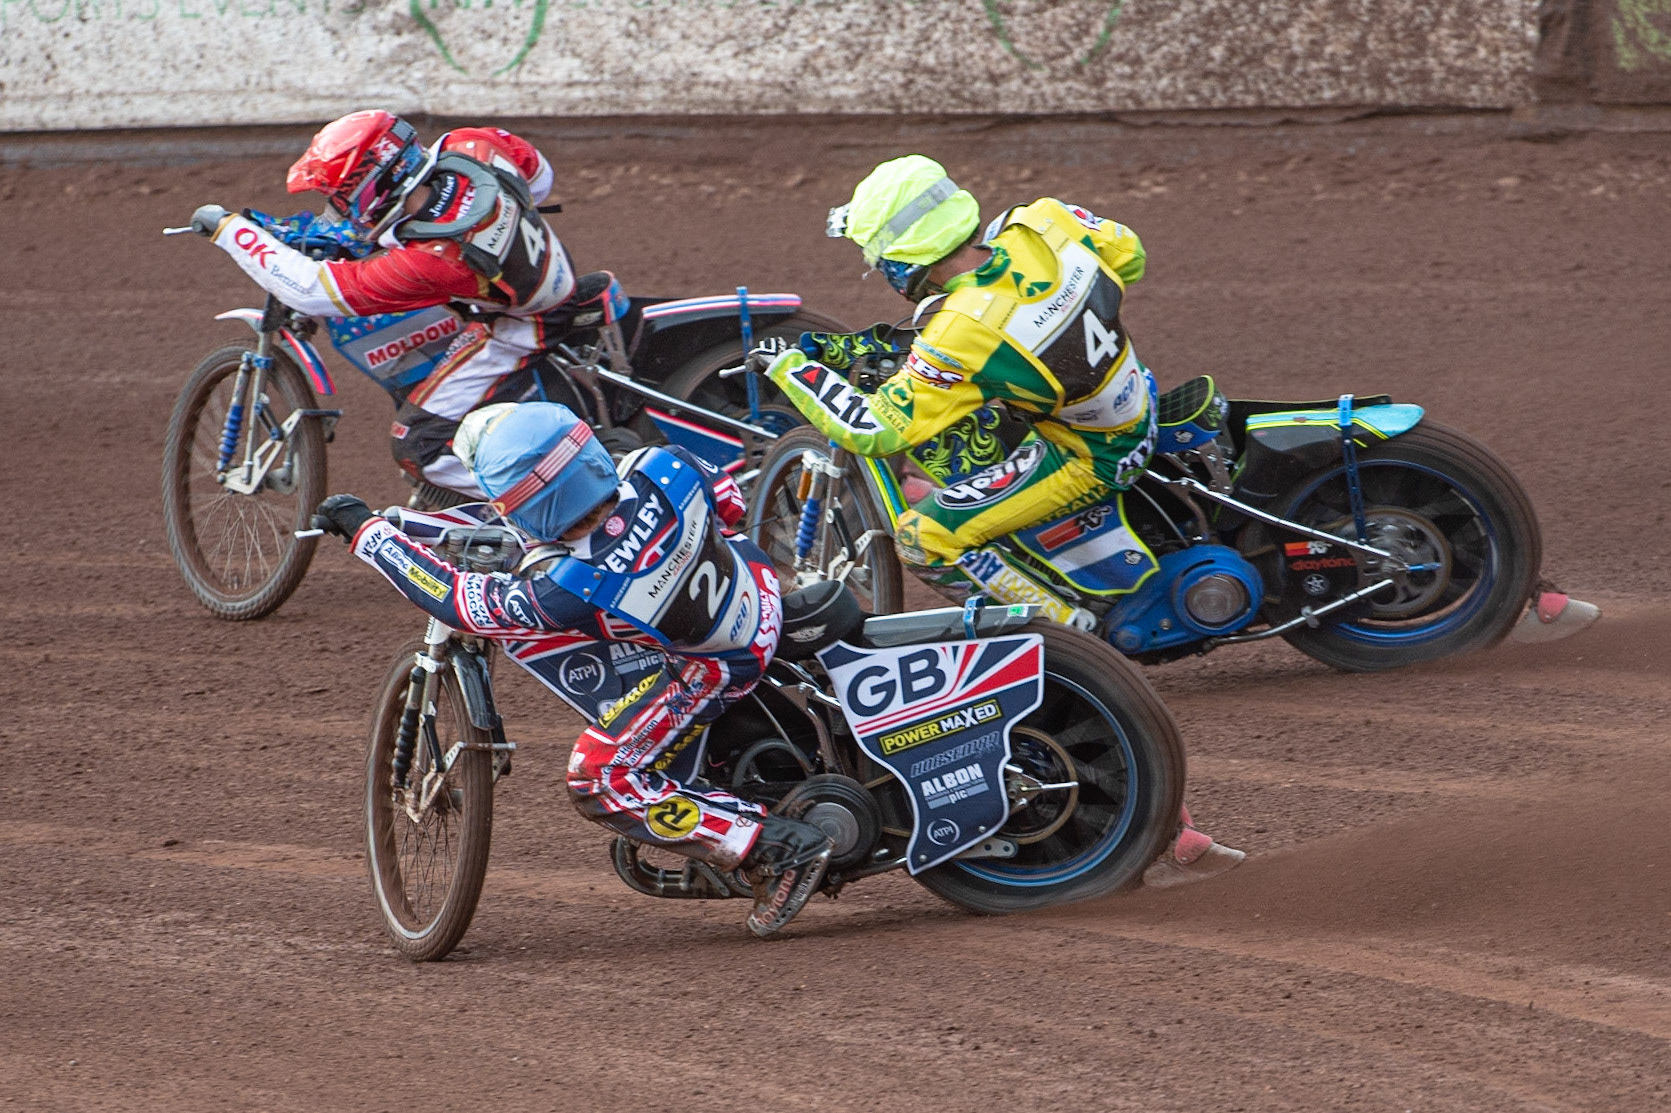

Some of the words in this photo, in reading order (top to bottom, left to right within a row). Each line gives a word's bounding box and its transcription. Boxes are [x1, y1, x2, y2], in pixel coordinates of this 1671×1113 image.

[234, 227, 278, 270] OK
[520, 216, 546, 268] 4
[1033, 266, 1085, 328] MANCHESTER
[366, 317, 459, 368] MOLDOW
[1082, 308, 1119, 368] 4
[648, 519, 698, 599] MANCHESTER
[688, 560, 731, 620] 2
[568, 664, 597, 684] ATPI
[847, 648, 947, 717] GB
[884, 723, 941, 752] POWER
[920, 763, 984, 797] ALBON
[933, 825, 954, 840] ATPI
